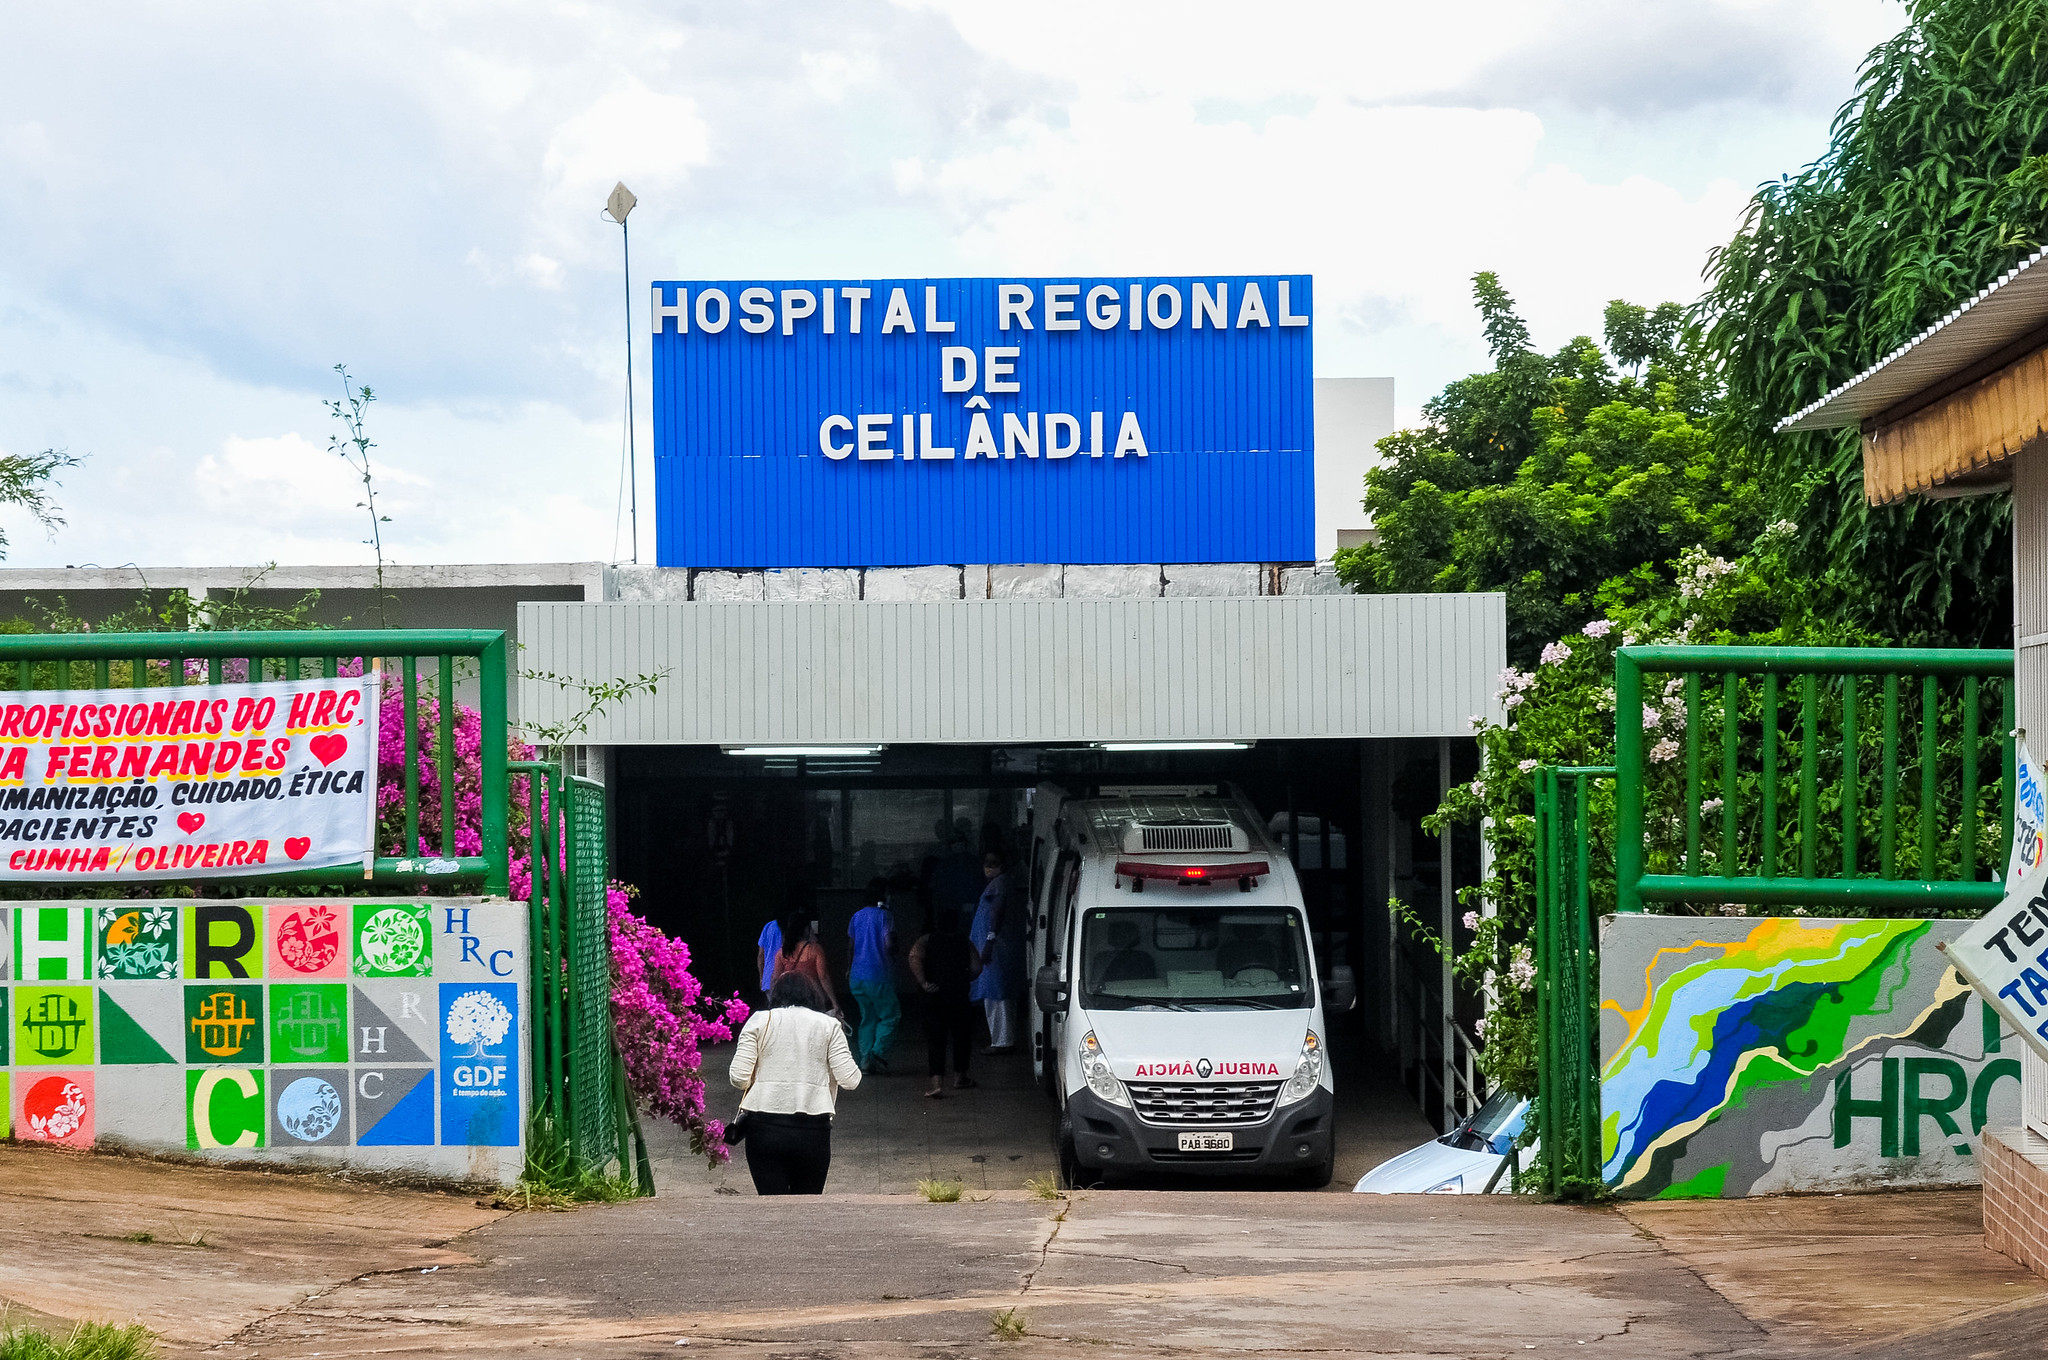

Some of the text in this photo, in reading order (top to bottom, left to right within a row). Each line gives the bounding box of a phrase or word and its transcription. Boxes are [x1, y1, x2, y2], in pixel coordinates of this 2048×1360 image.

[652, 280, 1309, 336] HOSPITAL REGIONAL
[941, 346, 1020, 393] DE
[819, 395, 1149, 460] CEILÂNDIA
[0, 690, 364, 738] ROFISSIONAIS DO HRC,
[45, 738, 291, 779] FERNANDES
[289, 765, 365, 797] ÉTICA
[22, 908, 84, 980] H
[196, 906, 256, 979] R
[453, 1065, 507, 1087] GDF
[193, 1070, 259, 1147] C
